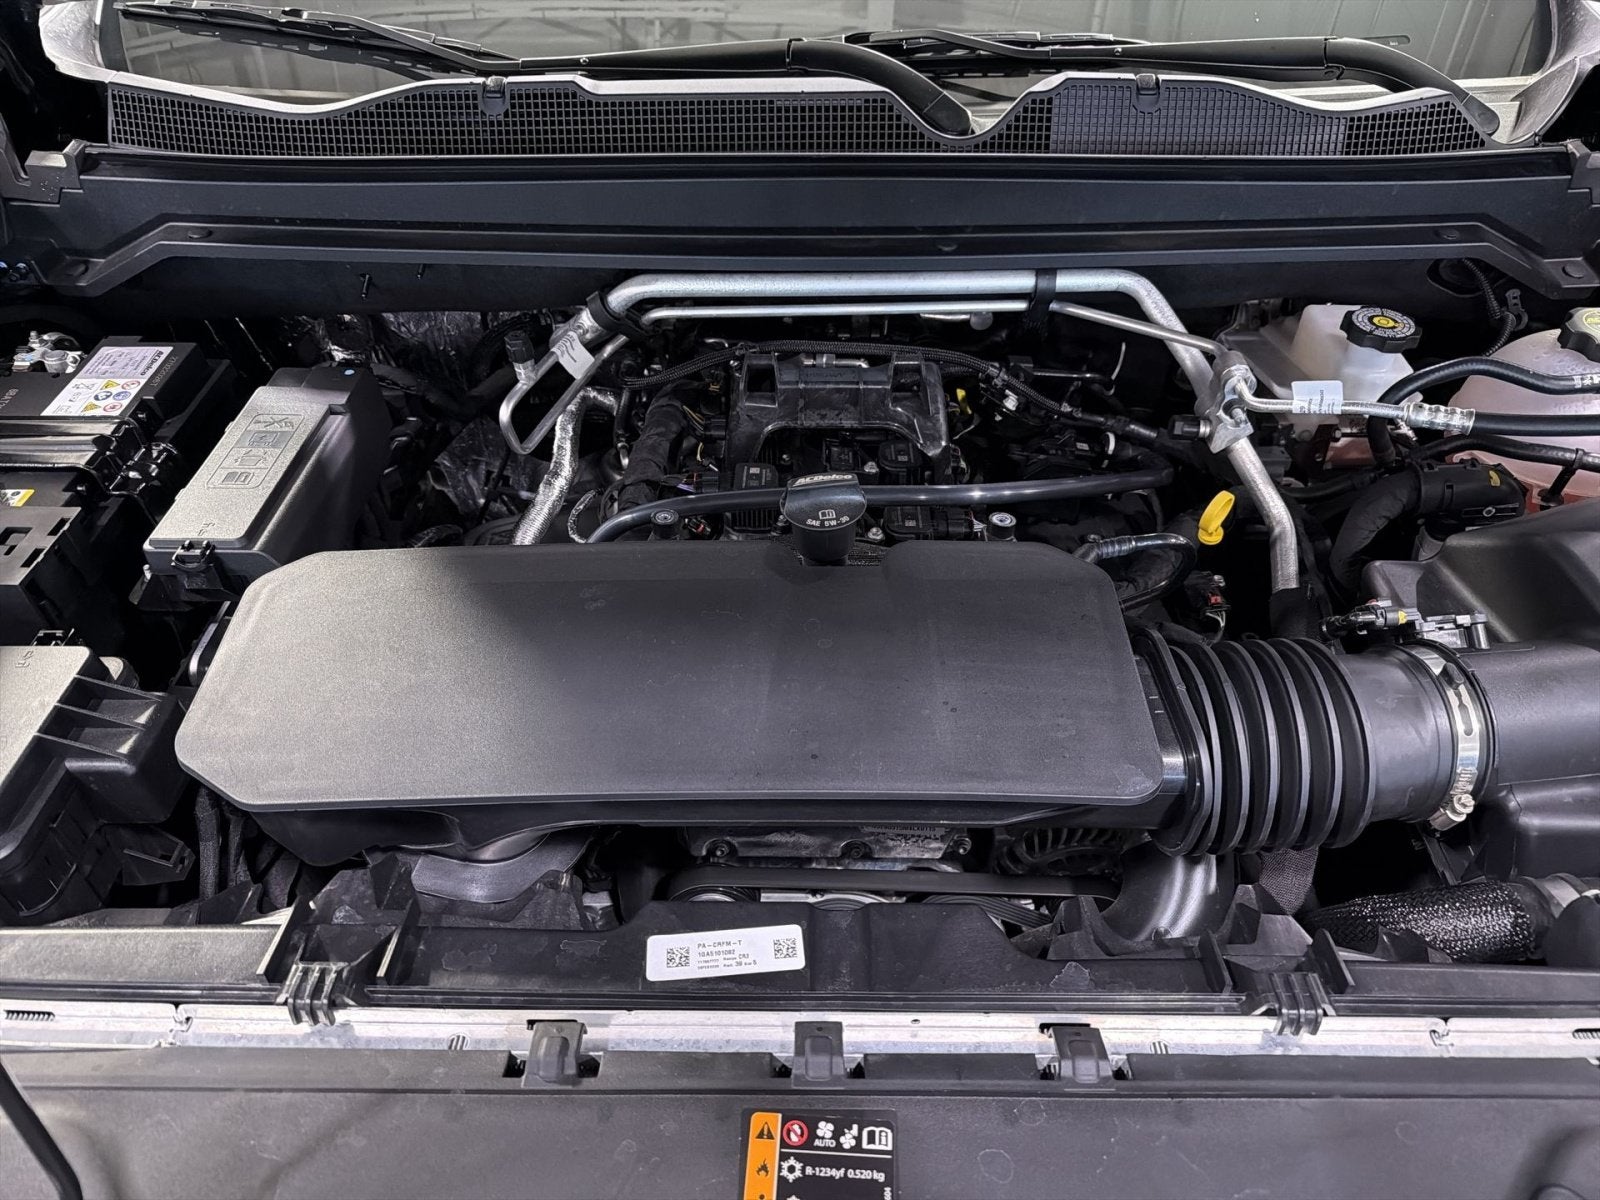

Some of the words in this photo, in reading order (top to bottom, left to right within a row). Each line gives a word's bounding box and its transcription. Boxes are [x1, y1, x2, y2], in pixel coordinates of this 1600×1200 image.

[140, 350, 164, 376] ACDelco
[793, 474, 853, 487] ACDelco
[806, 519, 821, 527] SAE
[824, 515, 850, 527] 5W-30
[814, 1139, 836, 1148] AUTO
[805, 1166, 845, 1179] R-1234yf
[847, 1169, 872, 1179] 0.520
[873, 1170, 885, 1182] kg
